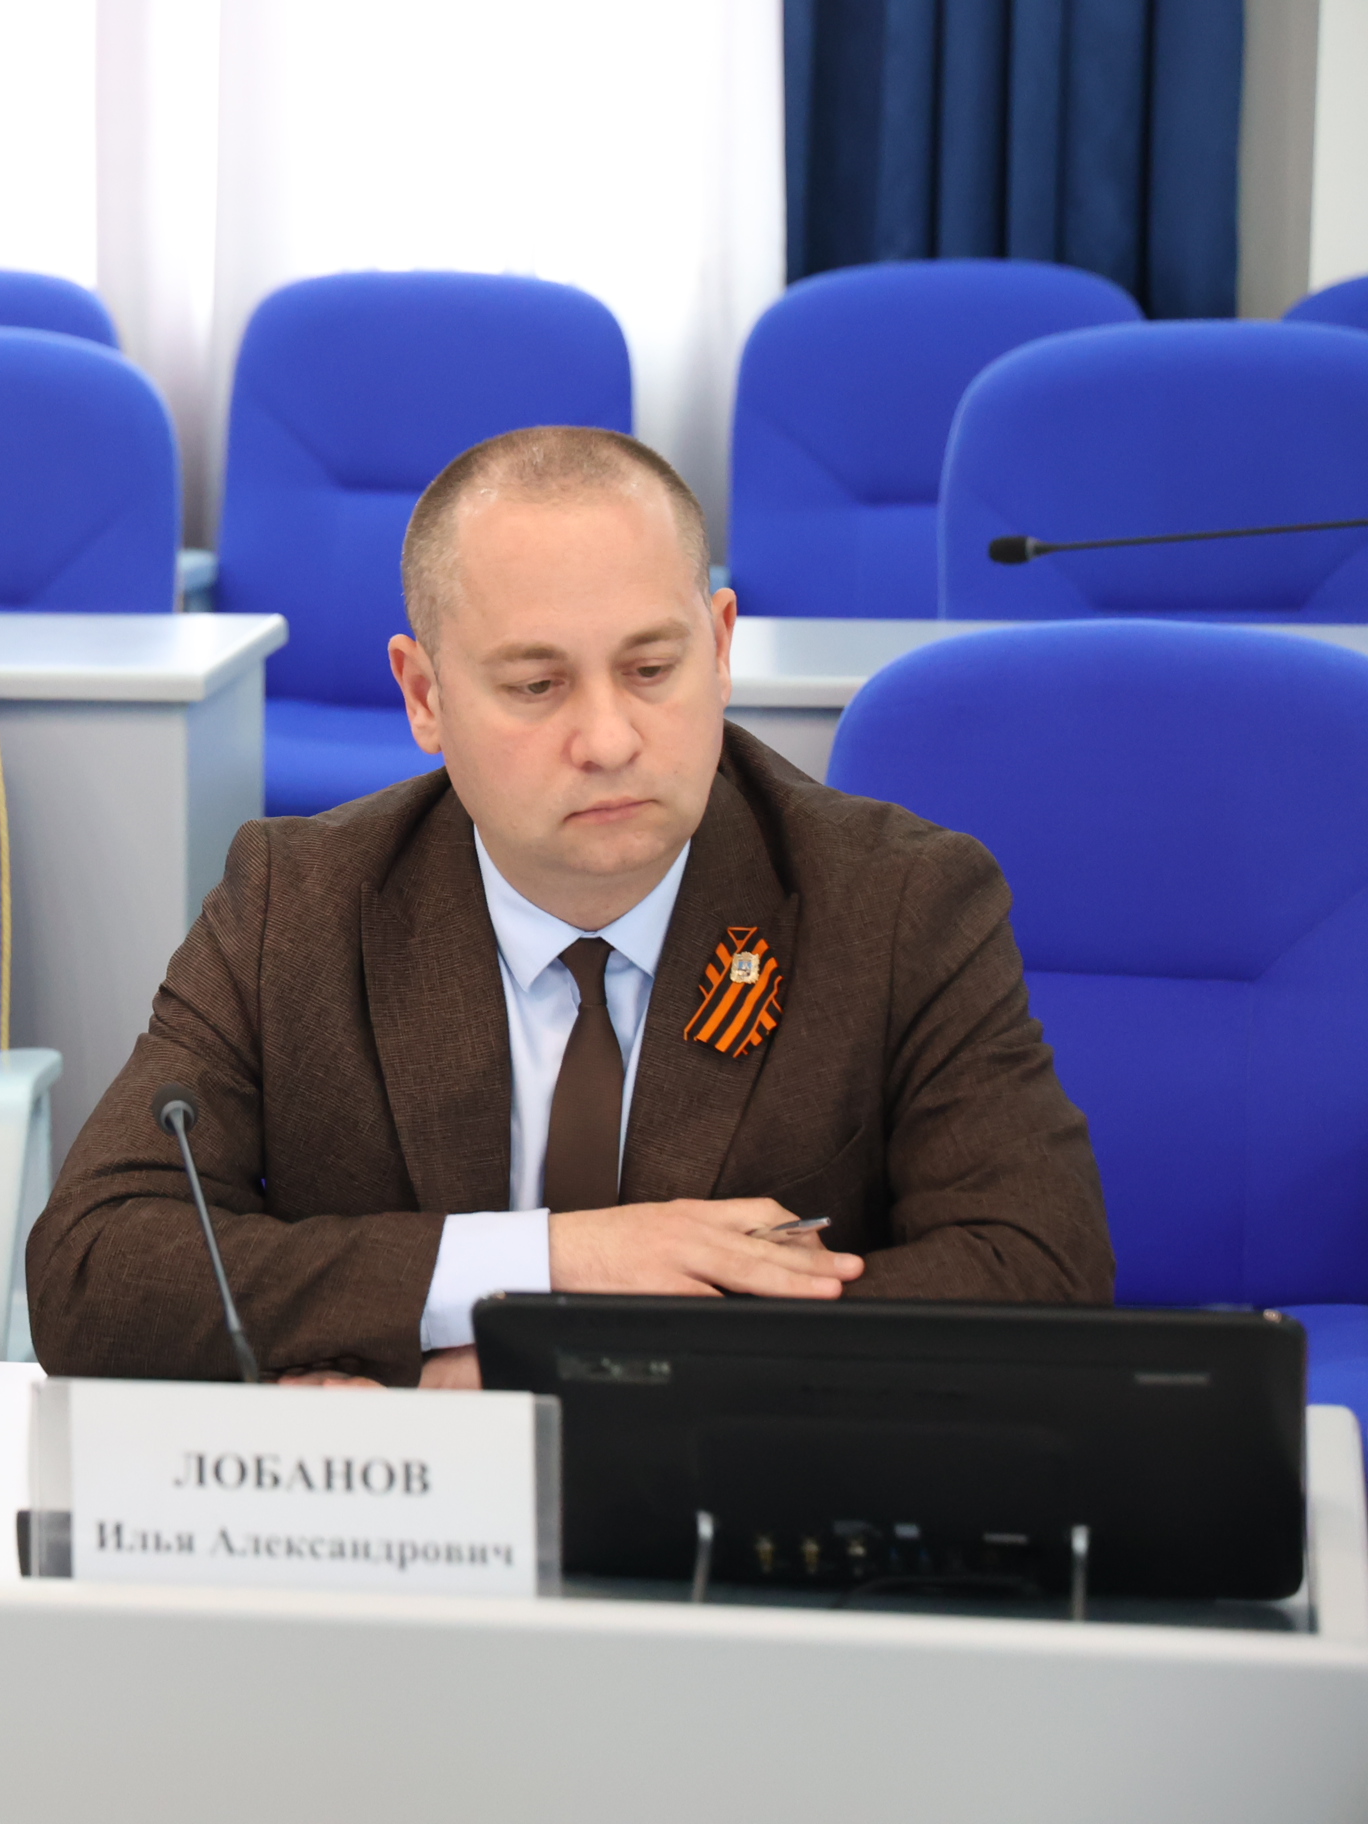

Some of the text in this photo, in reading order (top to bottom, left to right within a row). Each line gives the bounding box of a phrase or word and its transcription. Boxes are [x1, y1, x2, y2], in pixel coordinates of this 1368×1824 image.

[174, 1452, 431, 1494] ЛОБАНОВ
[96, 1520, 514, 1571] Илья Александрович
